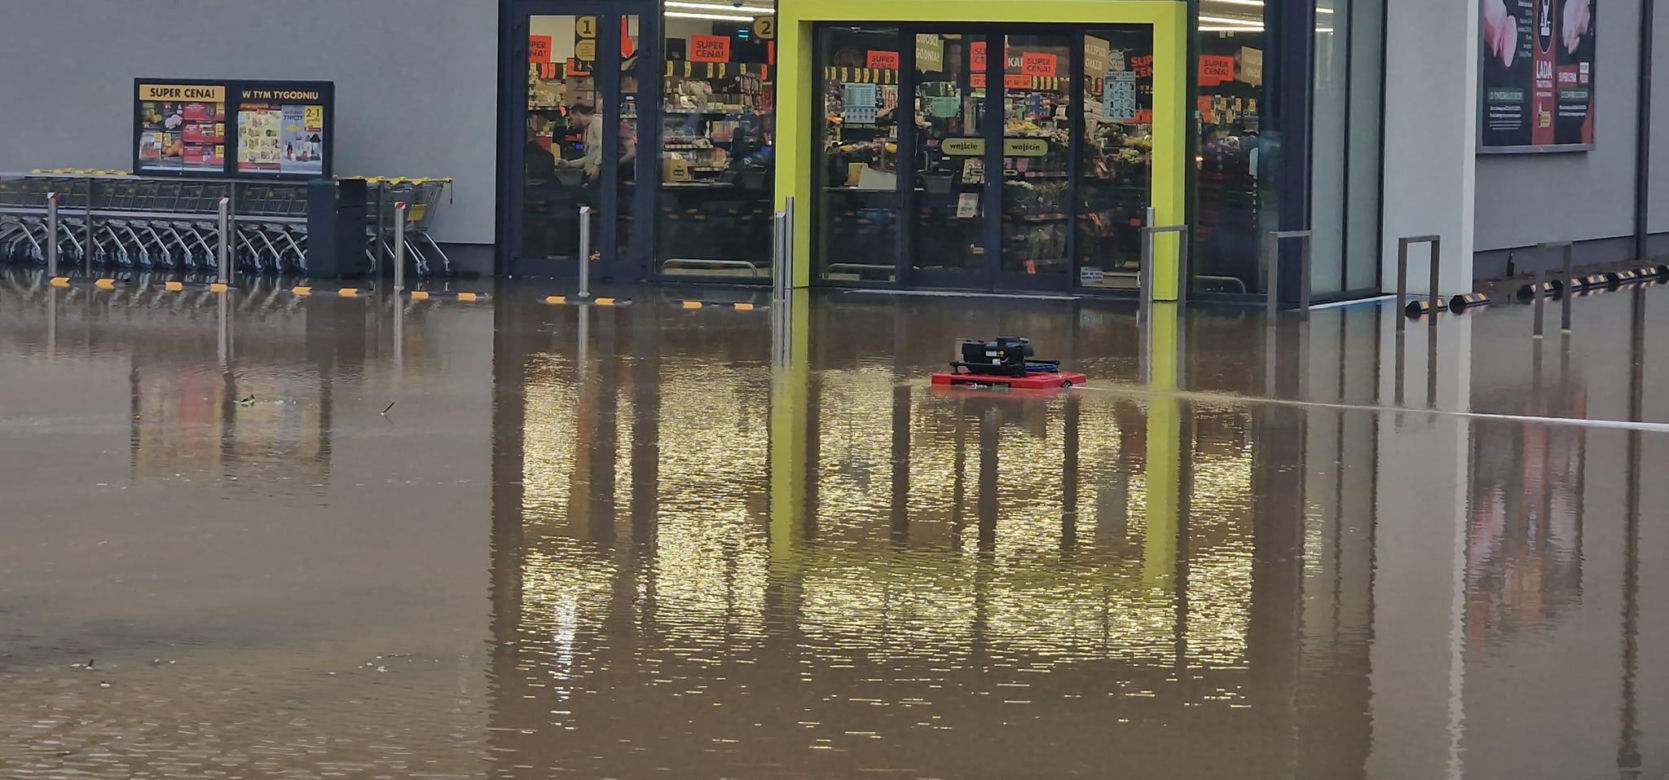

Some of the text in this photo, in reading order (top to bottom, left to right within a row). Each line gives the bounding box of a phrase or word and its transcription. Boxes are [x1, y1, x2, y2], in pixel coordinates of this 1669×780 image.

[583, 20, 592, 34] 1
[761, 21, 771, 34] 2
[696, 40, 724, 48] SUPER
[695, 49, 724, 57] CENA!
[1203, 59, 1229, 67] SUPER
[1026, 64, 1052, 72] CENA!
[1203, 67, 1229, 75] CENA!
[1536, 60, 1553, 79] LADA
[150, 88, 215, 98] SUPER CENA!
[241, 90, 319, 100] W TYM TYGODNIU
[949, 142, 978, 151] wejście
[1011, 143, 1040, 152] wejście
